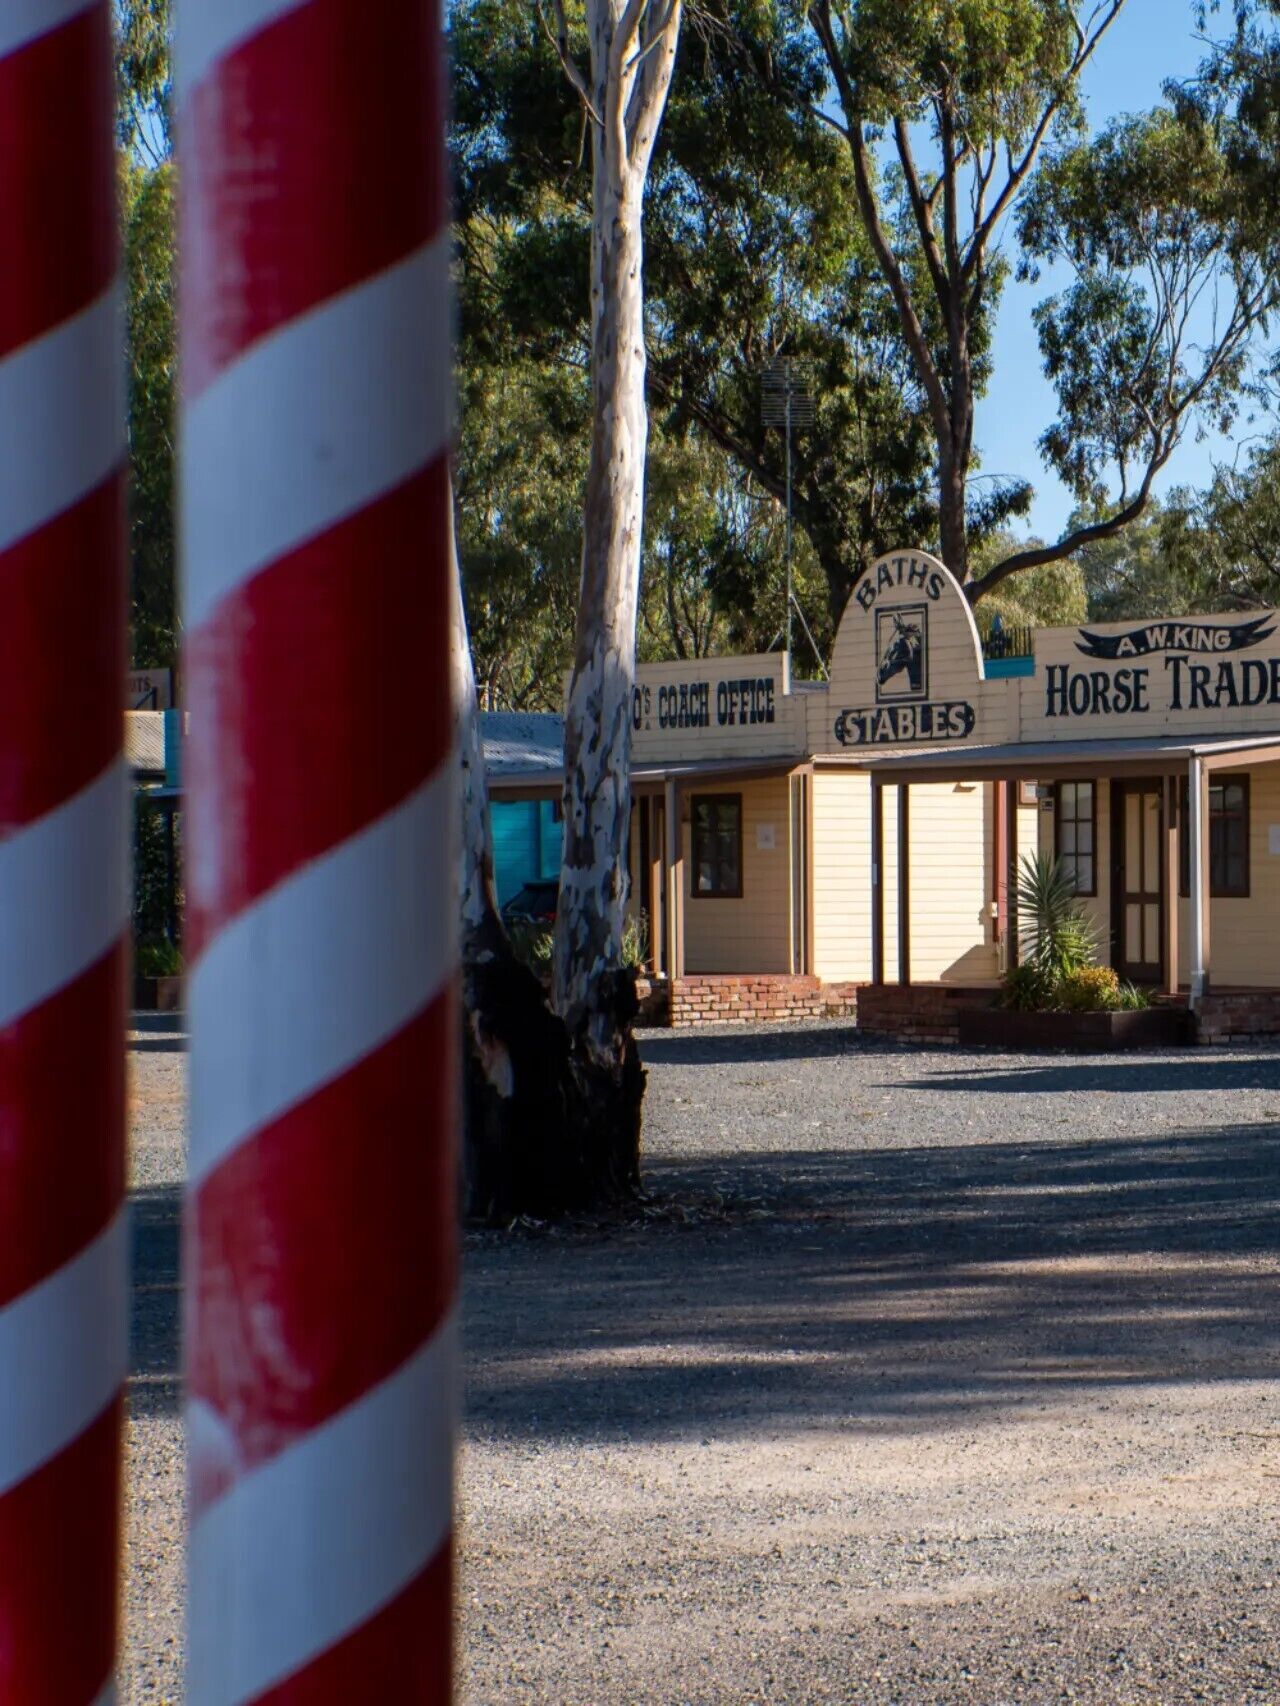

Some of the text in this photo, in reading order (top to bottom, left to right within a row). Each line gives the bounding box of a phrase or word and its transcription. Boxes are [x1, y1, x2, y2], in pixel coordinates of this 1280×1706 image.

[856, 557, 945, 612] BATHS
[659, 682, 709, 728] COACH
[717, 678, 774, 726] OFFICE
[1045, 664, 1149, 717] HORSE
[841, 705, 966, 743] STABLES
